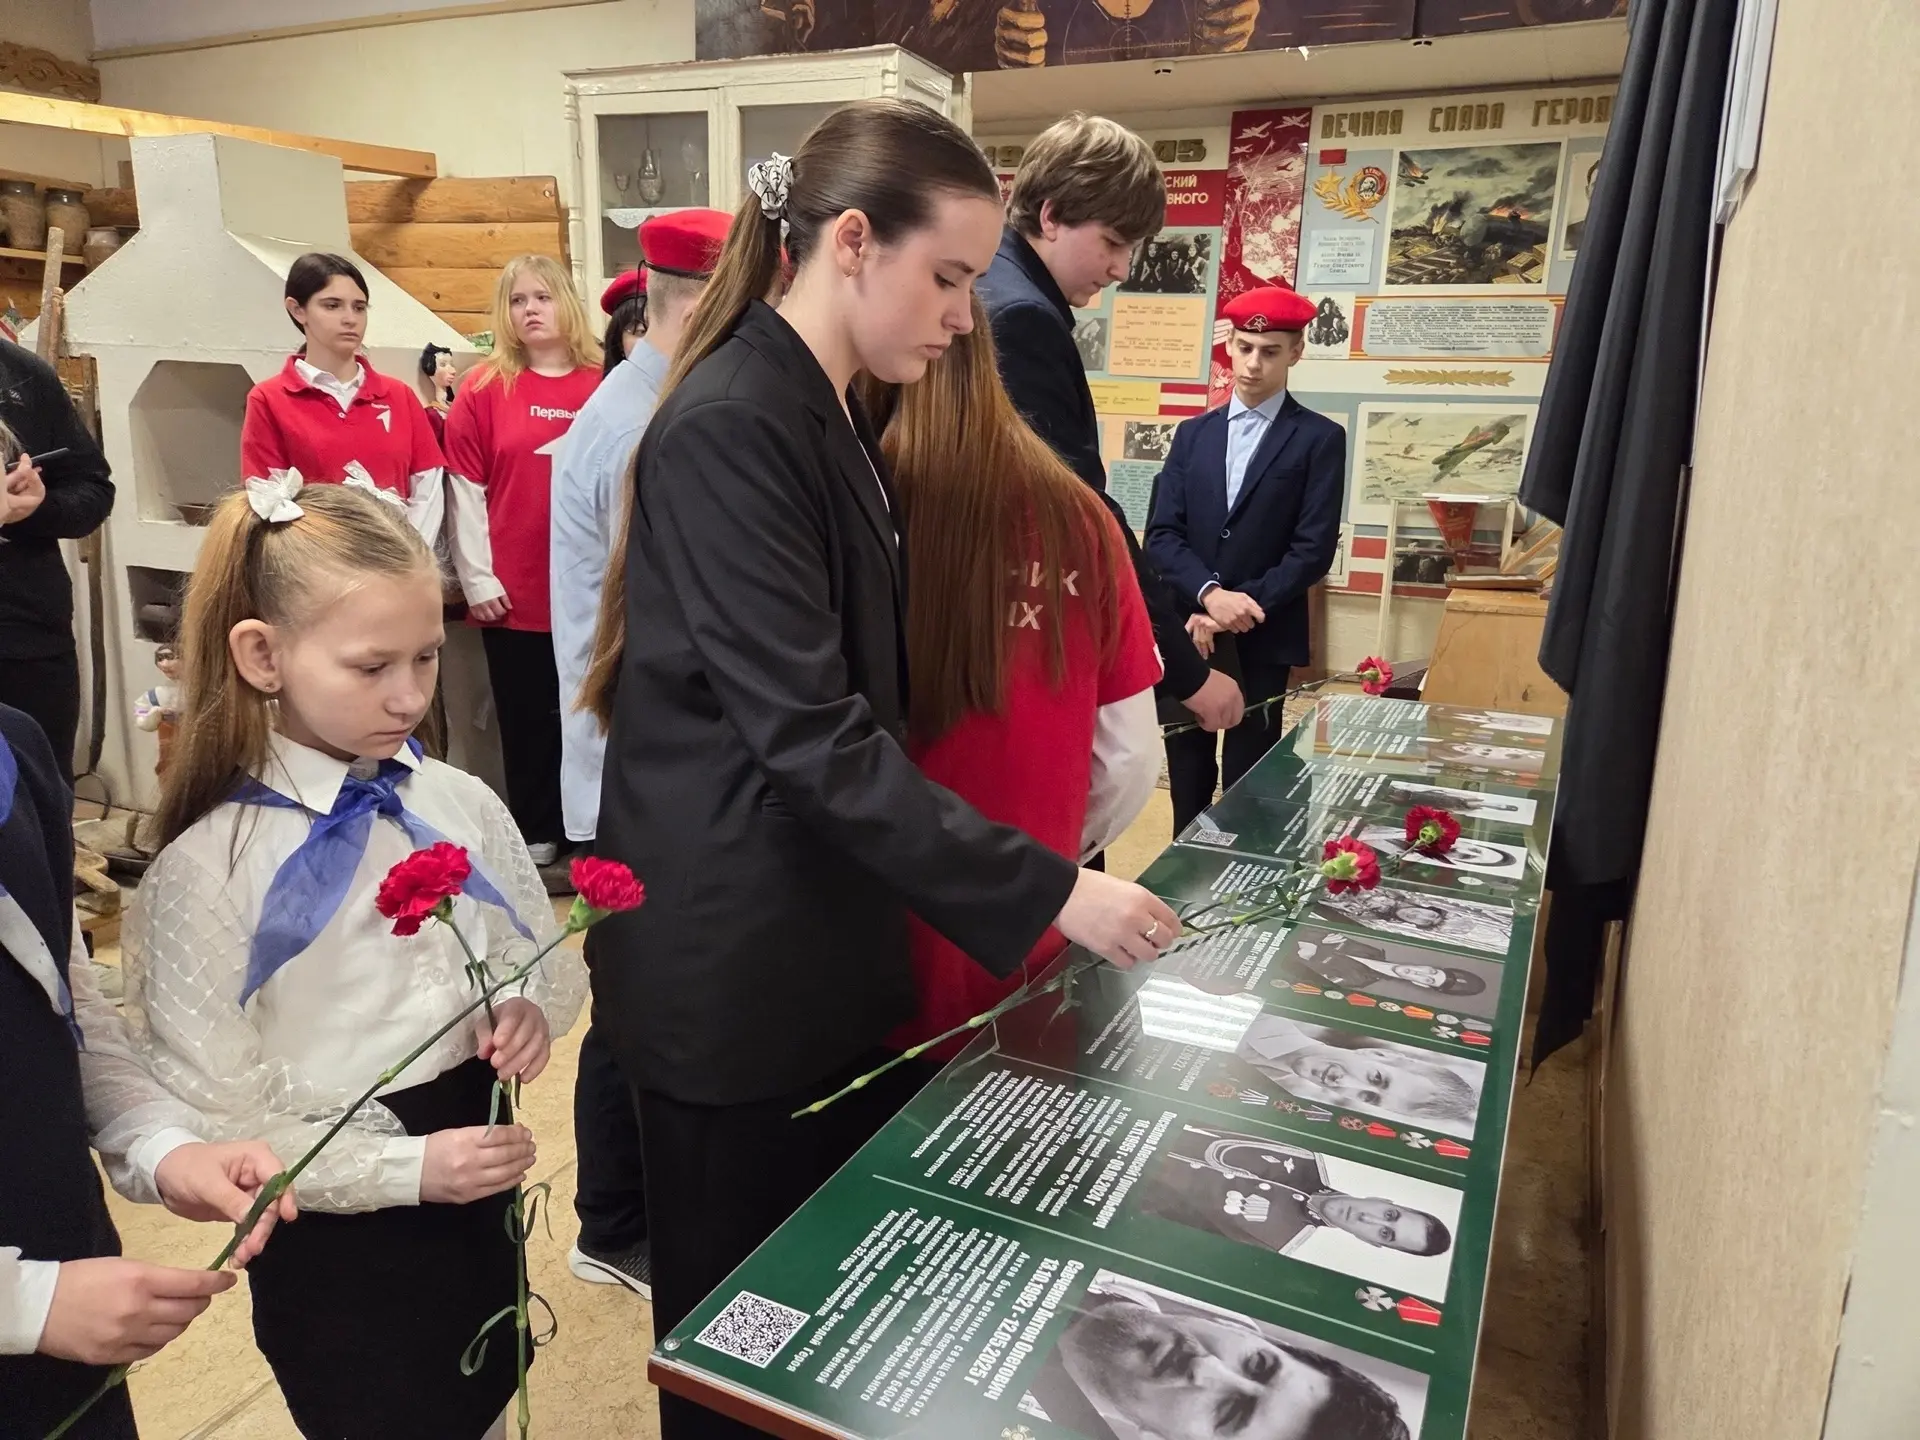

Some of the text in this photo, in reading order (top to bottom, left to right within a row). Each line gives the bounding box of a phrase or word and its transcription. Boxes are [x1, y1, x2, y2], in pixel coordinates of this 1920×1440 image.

[1321, 96, 1614, 139] ВЕЧНАЯ СЛАВА ГЕРОЯ
[1027, 1120, 1051, 1141] Алексей
[1075, 1133, 1098, 1155] институт
[1116, 1118, 1151, 1153] 18.11.1995
[1144, 1110, 1177, 1145] Пискалов
[1001, 1140, 1035, 1173] Григорьевич
[1088, 1136, 1110, 1158] Алексей
[1124, 1143, 1157, 1177] Алексей
[922, 1151, 952, 1178] ракетного
[958, 1164, 985, 1189] контракт
[1084, 1158, 1125, 1201] 09.06.2024
[982, 1173, 1009, 1197] получил
[1034, 1187, 1060, 1212] Ушакова
[1047, 1183, 1078, 1216] Балтийский
[1091, 1174, 1137, 1229] Григорьевич
[871, 1208, 899, 1231] Антону
[910, 1214, 942, 1246] операции.
[857, 1229, 881, 1247] было
[910, 1219, 955, 1265] обязанностей
[956, 1238, 990, 1271] клириком
[976, 1235, 1008, 1268] Димитрия
[812, 1206, 918, 1318] Российской Федерацией посмертно.
[835, 1253, 859, 1272] года.
[919, 1227, 982, 1298] собора города Пскова.
[1004, 1251, 1031, 1278] Антон
[783, 1217, 925, 1373] Антон Савченко награждён Звездой Героя
[888, 1273, 910, 1293] зоне
[953, 1266, 986, 1299] Донского
[990, 1278, 1012, 1298] был
[1013, 1255, 1061, 1309] 13.10.1992
[827, 1229, 963, 1390] Трагически погиб при исполнении пастырских
[845, 1293, 894, 1345] специальной
[908, 1271, 965, 1334] Свято-Троицкого
[943, 1297, 962, 1313] при
[889, 1239, 1021, 1414] настоятелем храма святого благоверного князя
[917, 1311, 953, 1347] воинской
[959, 1299, 997, 1343] военным
[982, 1258, 1085, 1402] Савченко Антон Олегович
[900, 1344, 928, 1370] части
[966, 1315, 1021, 1380] 12.05.2025
[813, 1346, 851, 1384] военной
[857, 1334, 917, 1402] кафедрального
[873, 1378, 903, 1408] 64044
